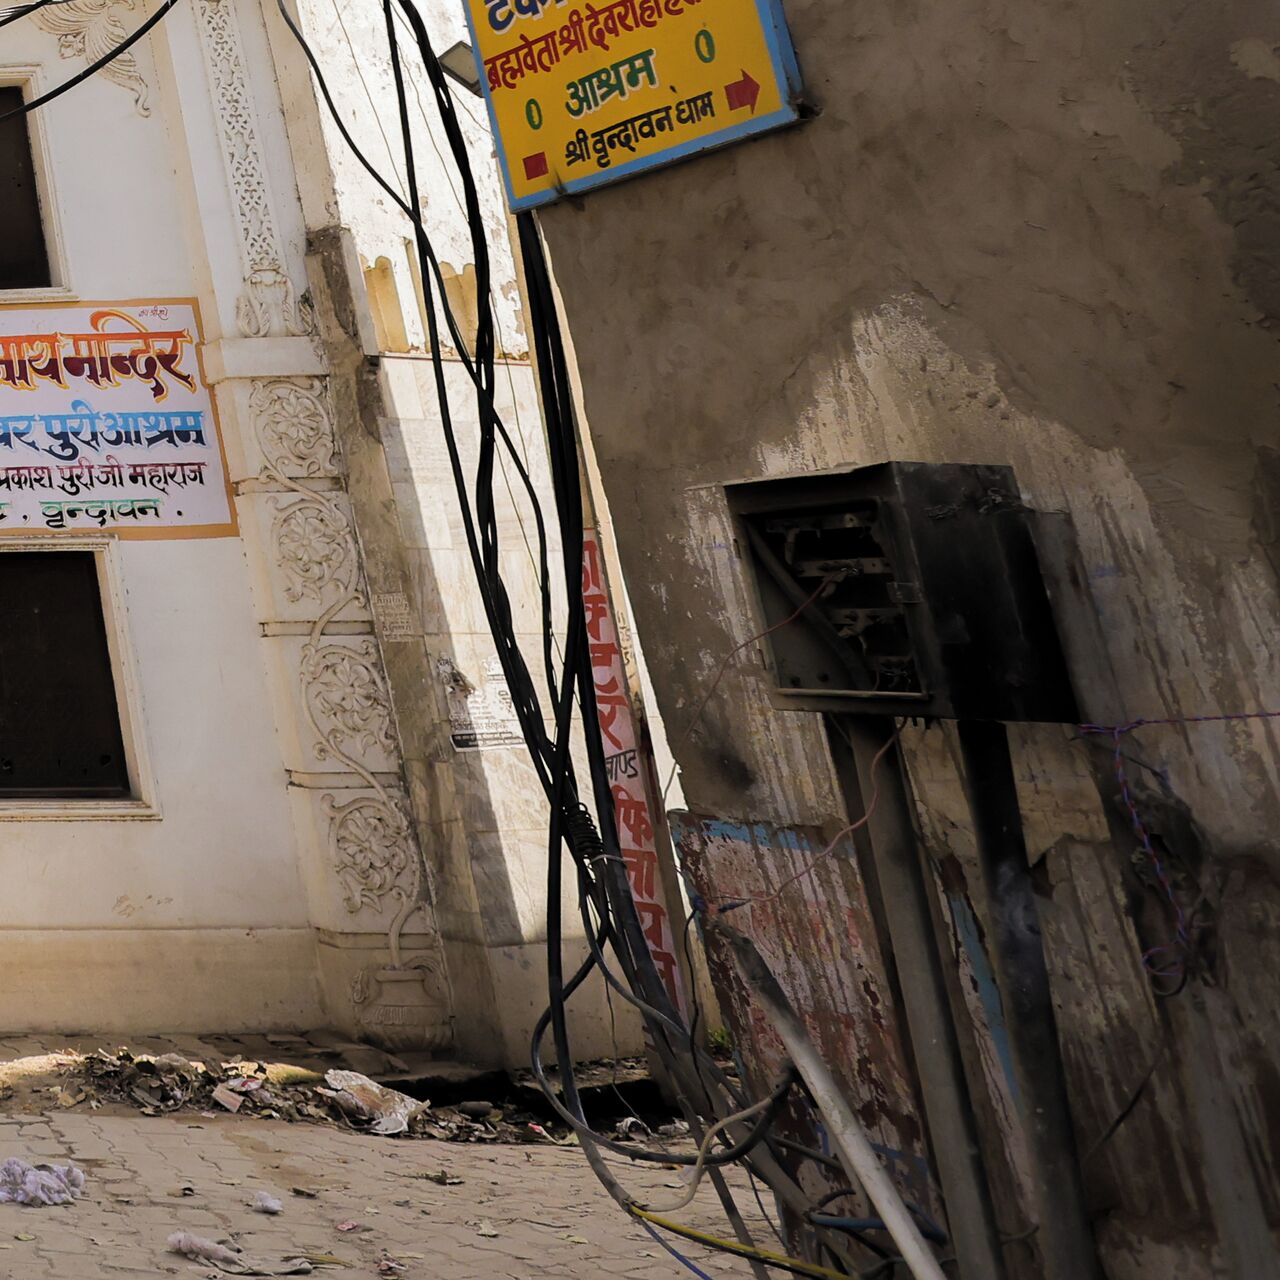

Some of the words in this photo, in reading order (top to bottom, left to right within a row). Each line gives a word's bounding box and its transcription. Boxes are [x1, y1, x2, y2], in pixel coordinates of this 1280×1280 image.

[559, 9, 588, 56] श्री
[585, 3, 662, 51] देवराहा
[565, 48, 655, 117] आश्रम
[565, 128, 591, 166] श्री
[591, 105, 674, 168] वृन्दावन
[676, 91, 715, 124] धाम
[40, 400, 100, 461] पुरी
[98, 411, 207, 447] आश्रम
[56, 456, 94, 496] पुरी
[95, 455, 124, 488] जी
[126, 462, 207, 495] महाराज
